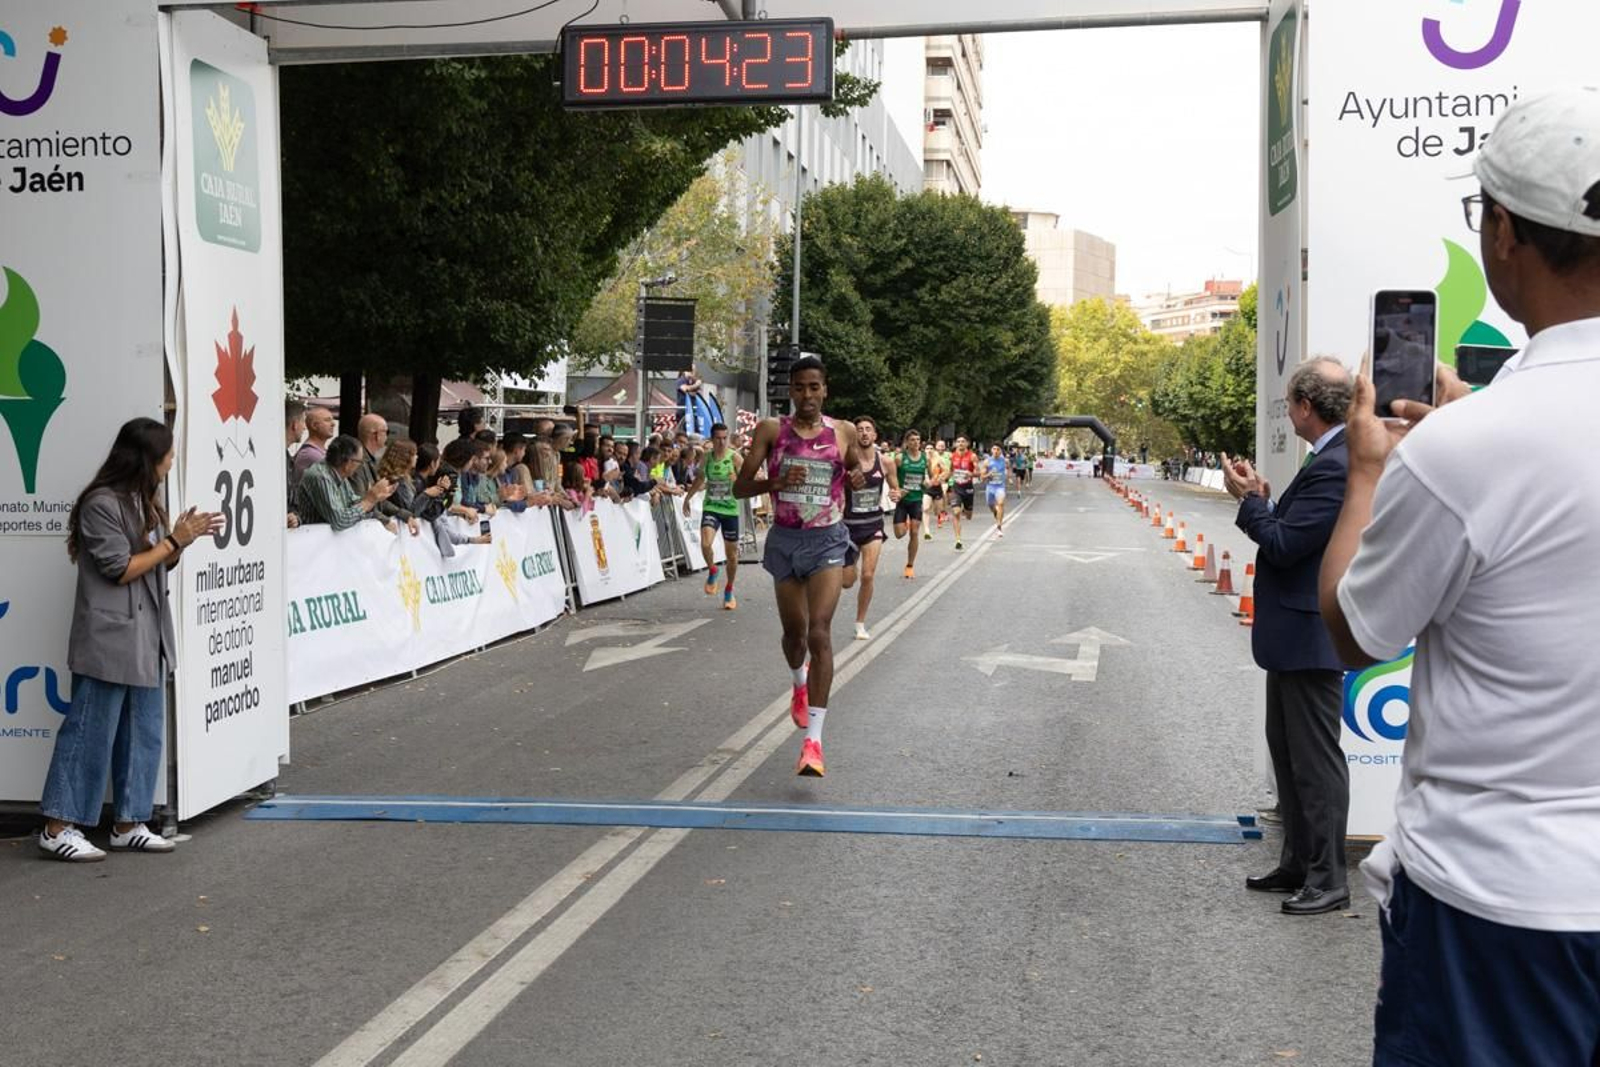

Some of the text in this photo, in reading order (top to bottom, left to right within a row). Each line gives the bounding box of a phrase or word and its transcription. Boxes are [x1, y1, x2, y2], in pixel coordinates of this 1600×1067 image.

[580, 32, 812, 93] 00:04:23
[1397, 126, 1491, 157] de J
[8, 165, 84, 193] Jaén
[0, 501, 29, 513] nato
[213, 469, 254, 550] 36
[46, 519, 62, 531] de
[196, 558, 265, 592] milla urbana
[196, 585, 264, 626] internacional
[304, 590, 367, 631] RURAL
[208, 621, 254, 655] de otoño
[211, 651, 253, 689] manuel
[205, 686, 260, 732] pancorbo
[1347, 754, 1402, 765] POSIT
